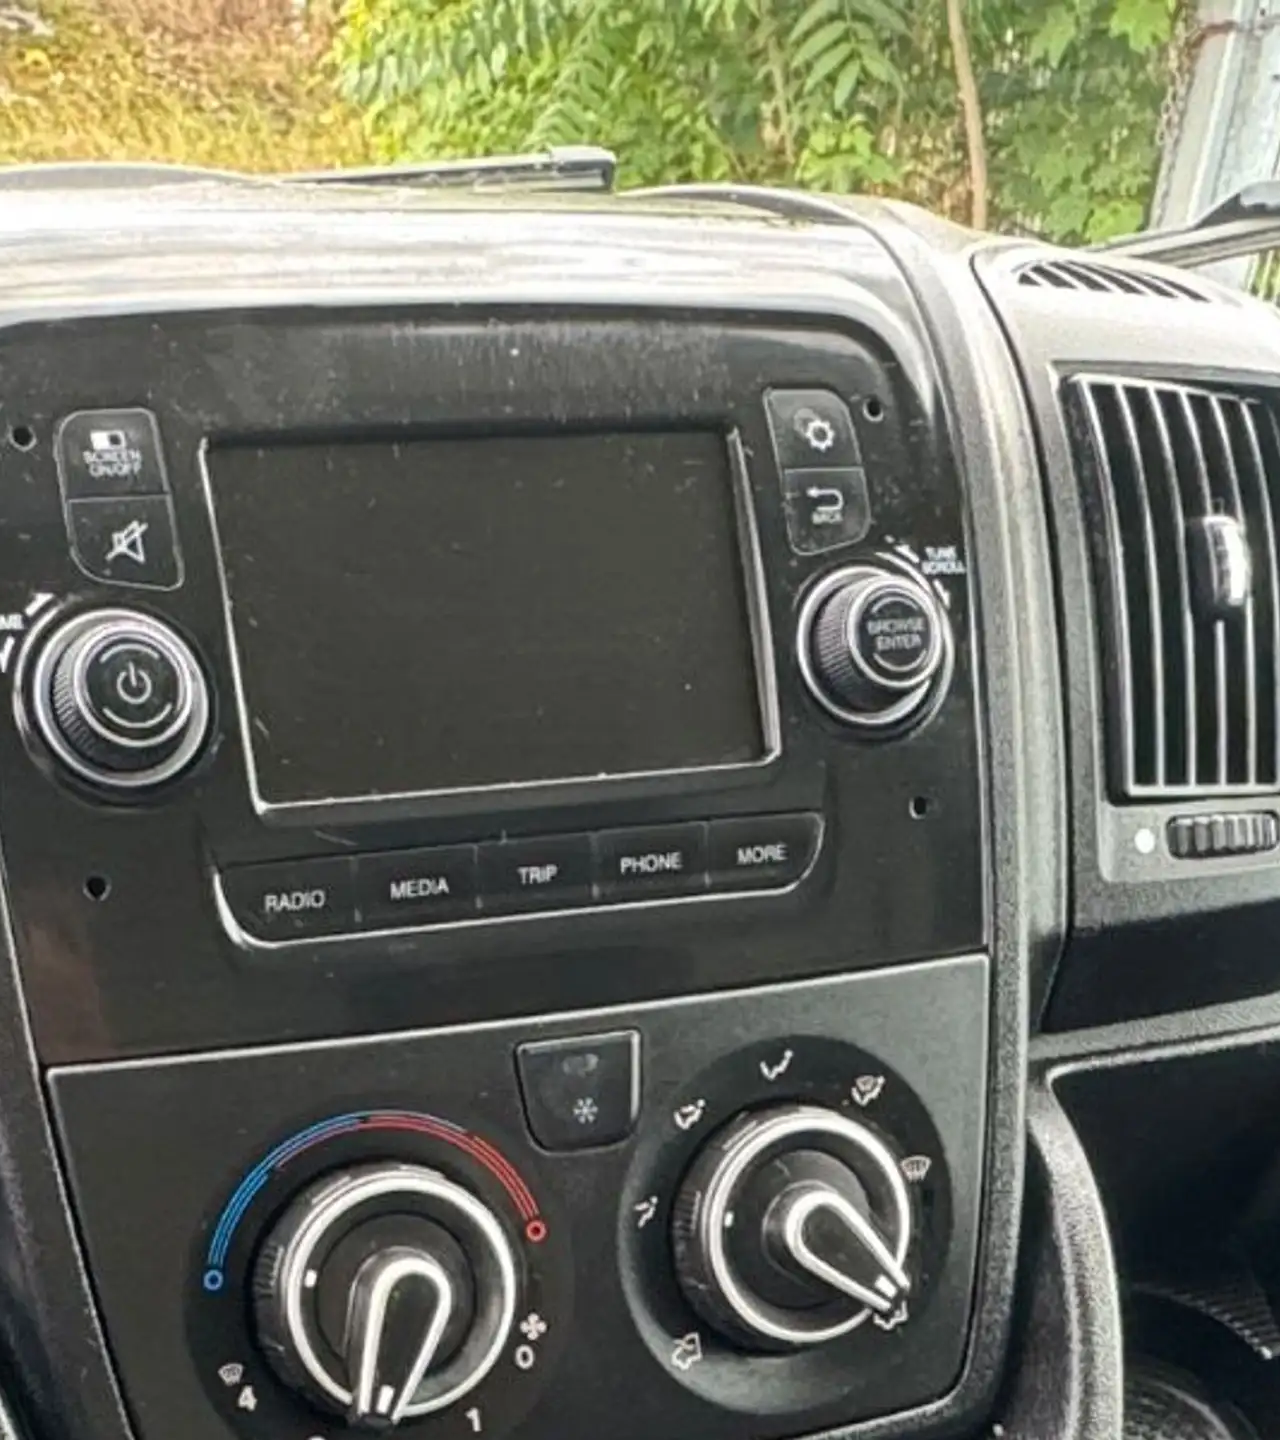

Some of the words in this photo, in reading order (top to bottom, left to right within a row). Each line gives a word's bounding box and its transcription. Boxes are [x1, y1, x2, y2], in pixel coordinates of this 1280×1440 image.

[83, 449, 143, 464] SCREEN
[89, 461, 143, 478] ON/OFF
[921, 559, 966, 575] SCROLL
[867, 616, 926, 635] BROWSE
[875, 632, 922, 651] ENTER
[620, 851, 683, 875] PHONE
[736, 842, 788, 865] MORE
[517, 864, 558, 885] TRIP
[390, 877, 450, 900] MEDIA
[263, 889, 326, 913] RADIO
[515, 1345, 535, 1369] 0
[237, 1385, 257, 1411] 4
[466, 1407, 482, 1433] 1
